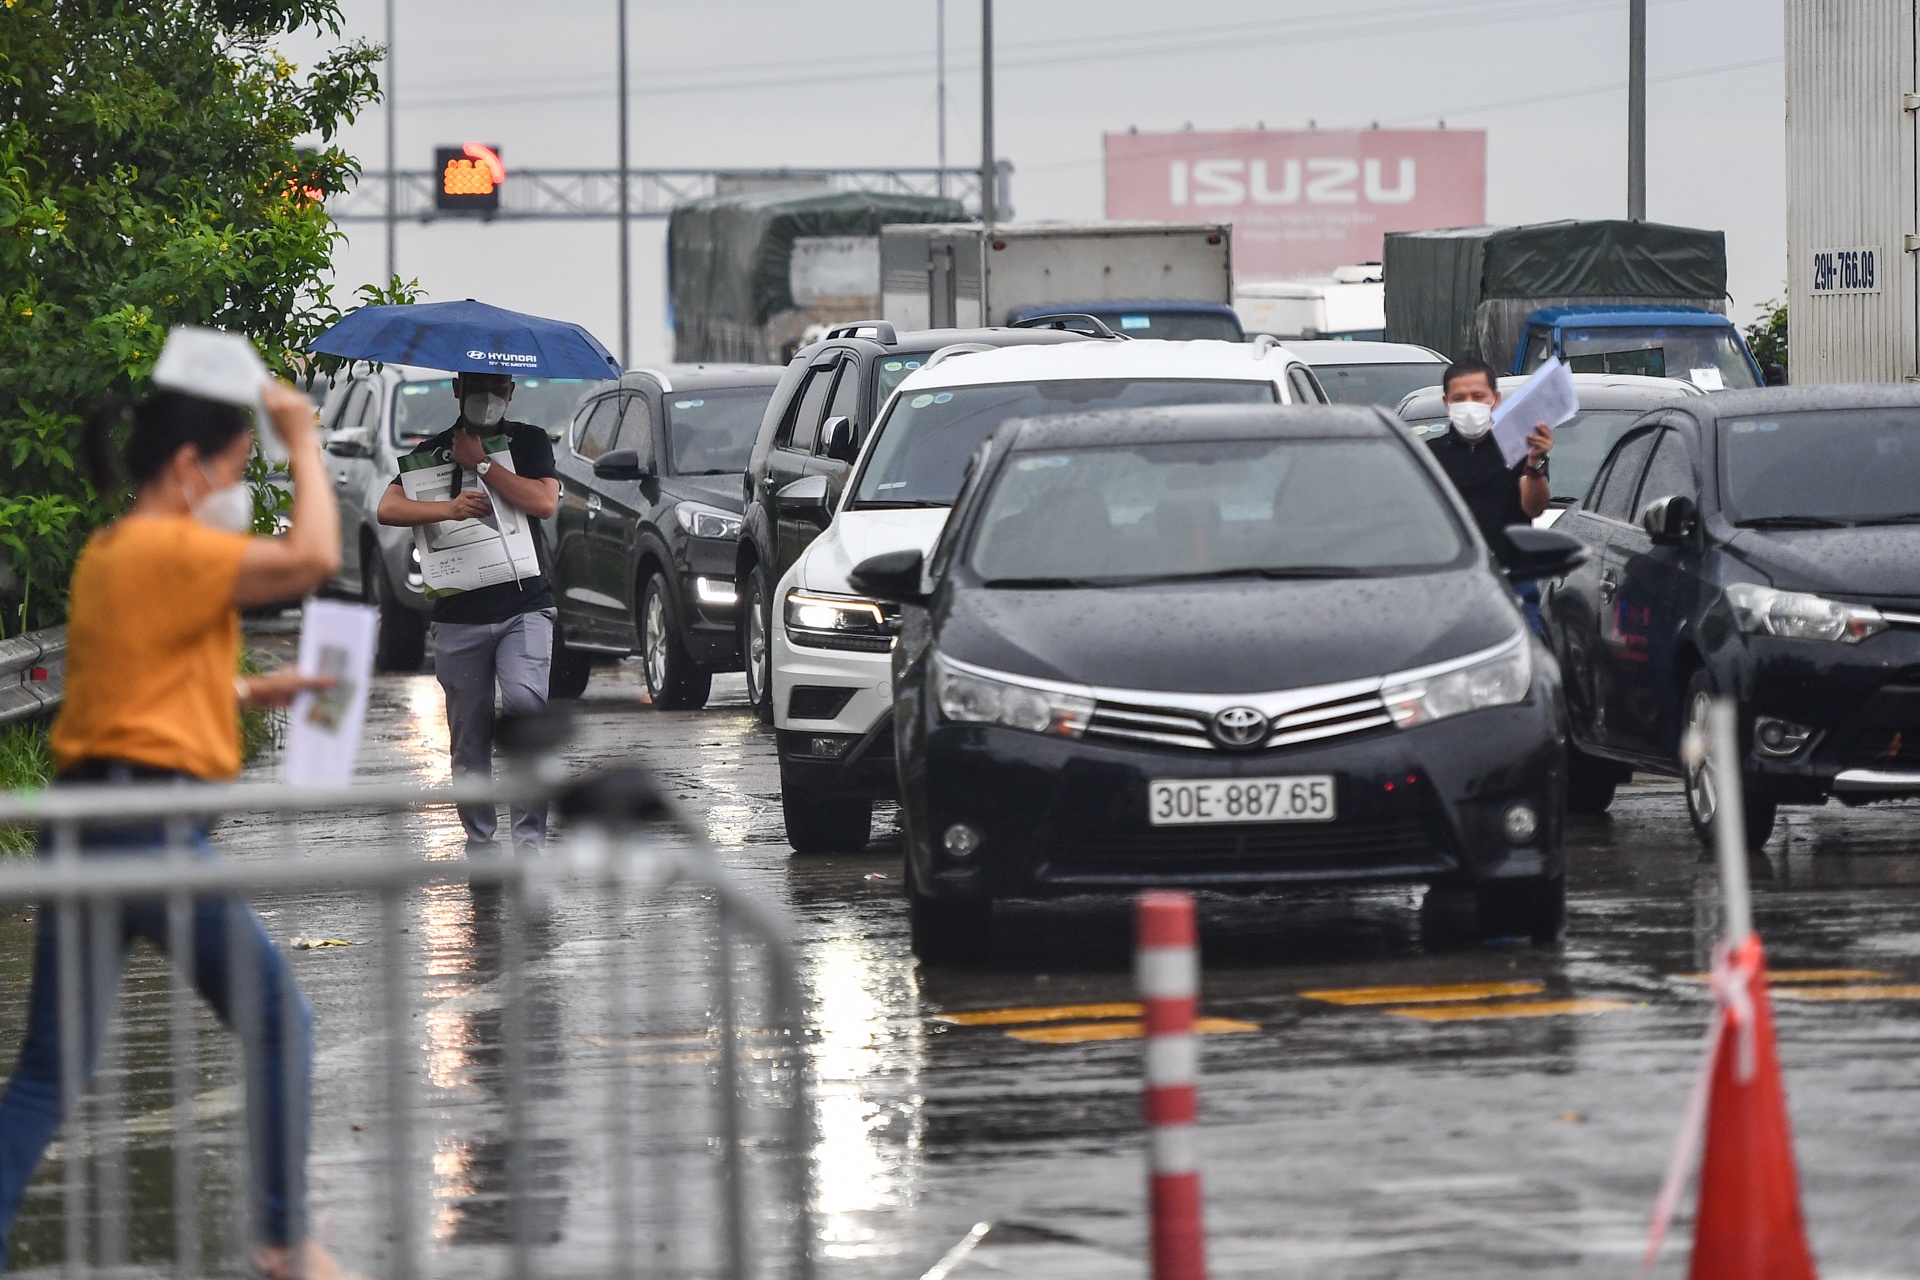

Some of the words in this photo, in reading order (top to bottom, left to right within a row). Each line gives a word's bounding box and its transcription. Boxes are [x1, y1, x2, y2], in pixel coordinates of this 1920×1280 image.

[1170, 157, 1417, 207] ISUZU
[1814, 250, 1874, 290] 29H-766.09
[488, 352, 537, 362] HYUNDAI
[1157, 782, 1328, 818] 30E-887.65
